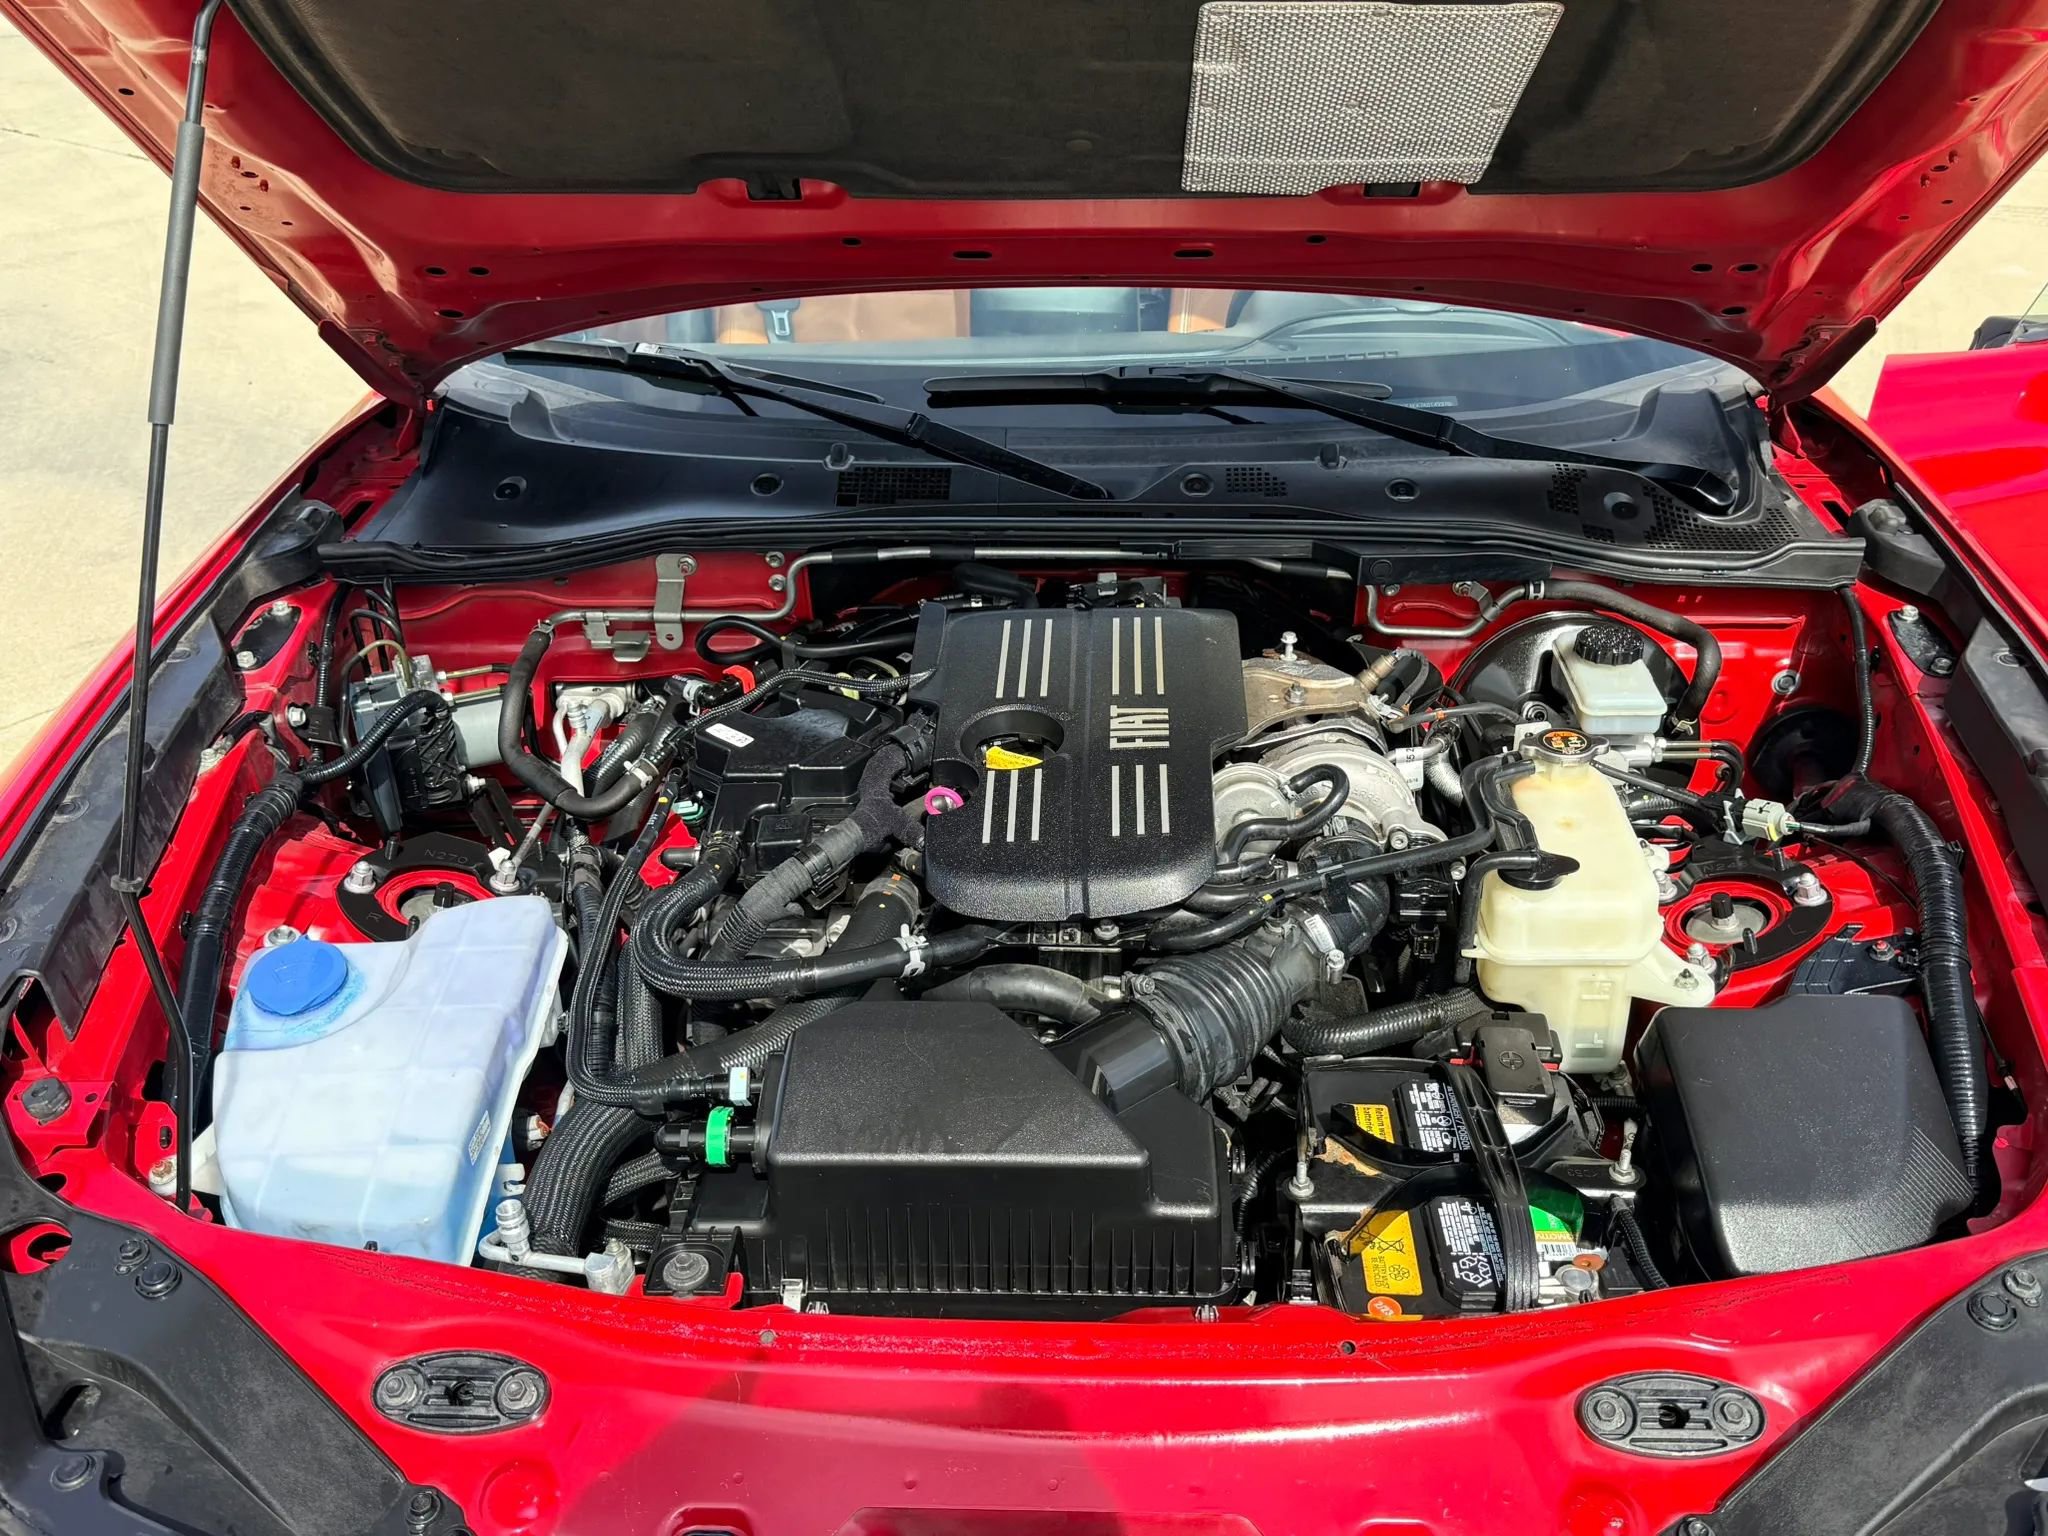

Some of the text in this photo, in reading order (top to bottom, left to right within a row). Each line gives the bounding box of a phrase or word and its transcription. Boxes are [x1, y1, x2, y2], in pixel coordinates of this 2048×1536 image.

[1110, 704, 1169, 750] FIAT
[1374, 1107, 1385, 1127] Return
[1457, 1125, 1472, 1151] POISON
